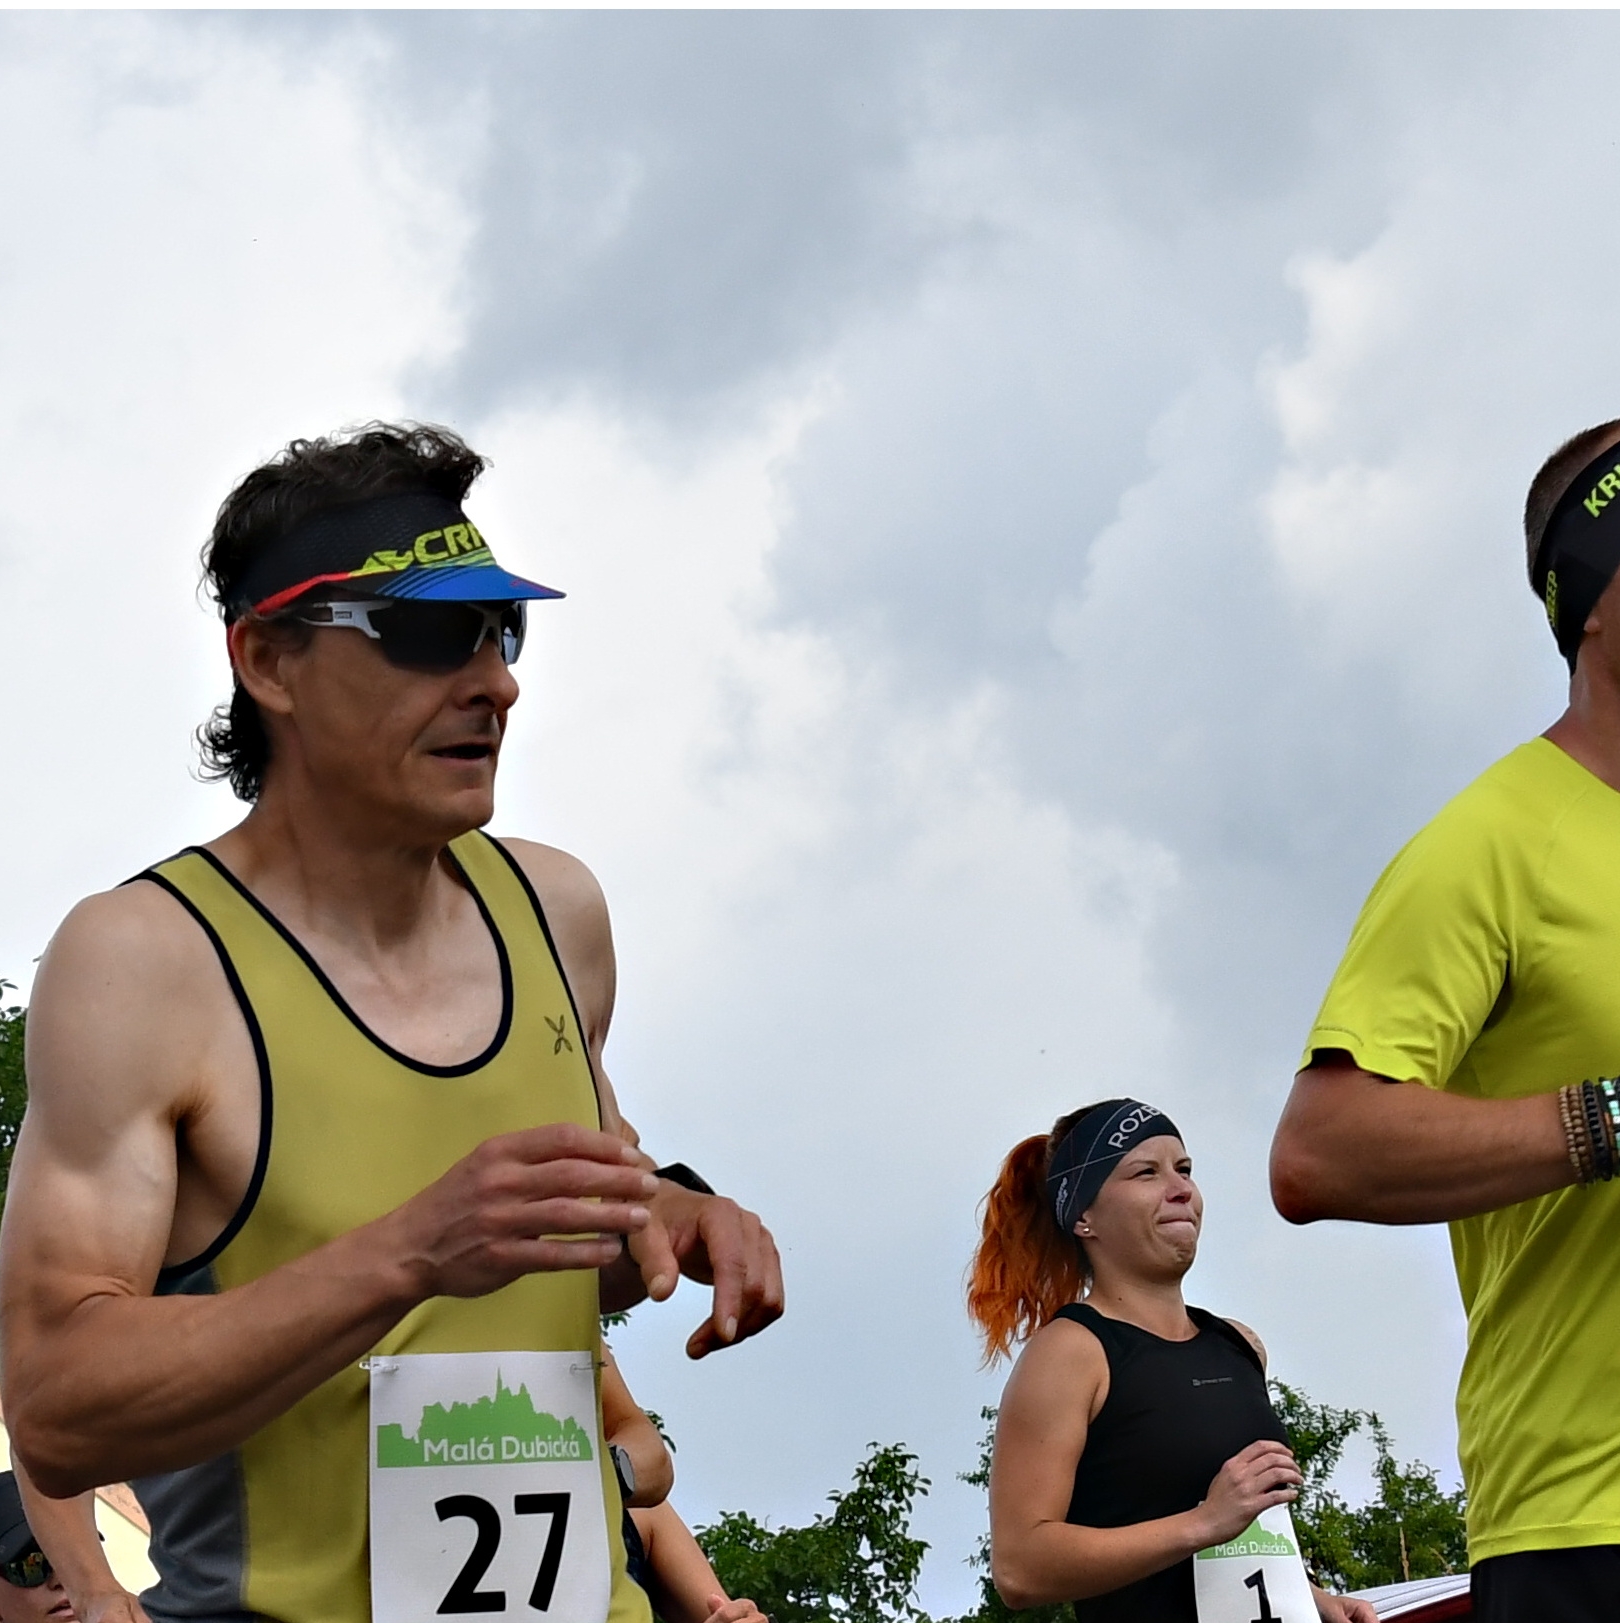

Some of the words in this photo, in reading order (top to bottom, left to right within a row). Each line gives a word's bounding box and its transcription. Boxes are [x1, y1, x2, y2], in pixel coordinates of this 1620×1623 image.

[423, 1437, 495, 1463] Malá
[501, 1434, 580, 1460] Dubická
[434, 1492, 571, 1614] 27
[1215, 1543, 1247, 1556] Malá
[1250, 1541, 1288, 1554] Dubická
